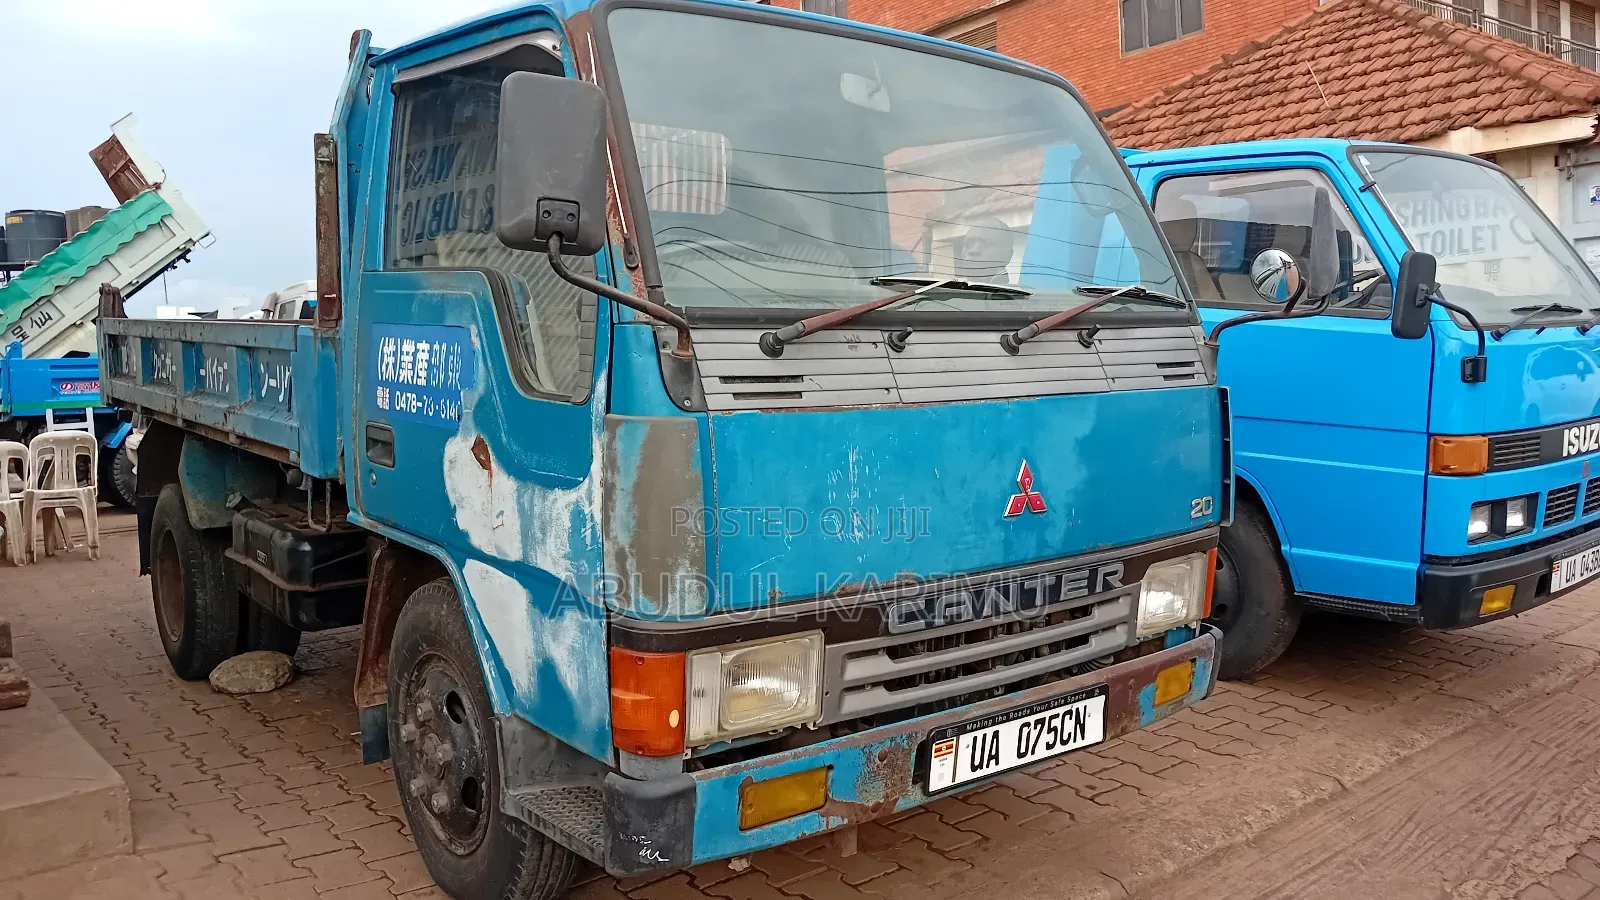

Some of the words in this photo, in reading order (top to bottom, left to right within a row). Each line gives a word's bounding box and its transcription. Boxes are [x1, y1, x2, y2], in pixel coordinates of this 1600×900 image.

[1416, 224, 1502, 259] TOILET
[1562, 423, 1600, 458] ISUZ
[1190, 495, 1213, 519] 20
[1565, 558, 1577, 584] UA
[888, 562, 1125, 635] CANTER
[966, 717, 993, 731] Making
[995, 714, 1007, 723] the
[1009, 708, 1030, 719] Roads
[1033, 702, 1048, 713] Your
[1050, 698, 1065, 708] Safe
[1066, 692, 1087, 703] Space
[970, 730, 1000, 773] UA
[1016, 704, 1088, 760] 075CN
